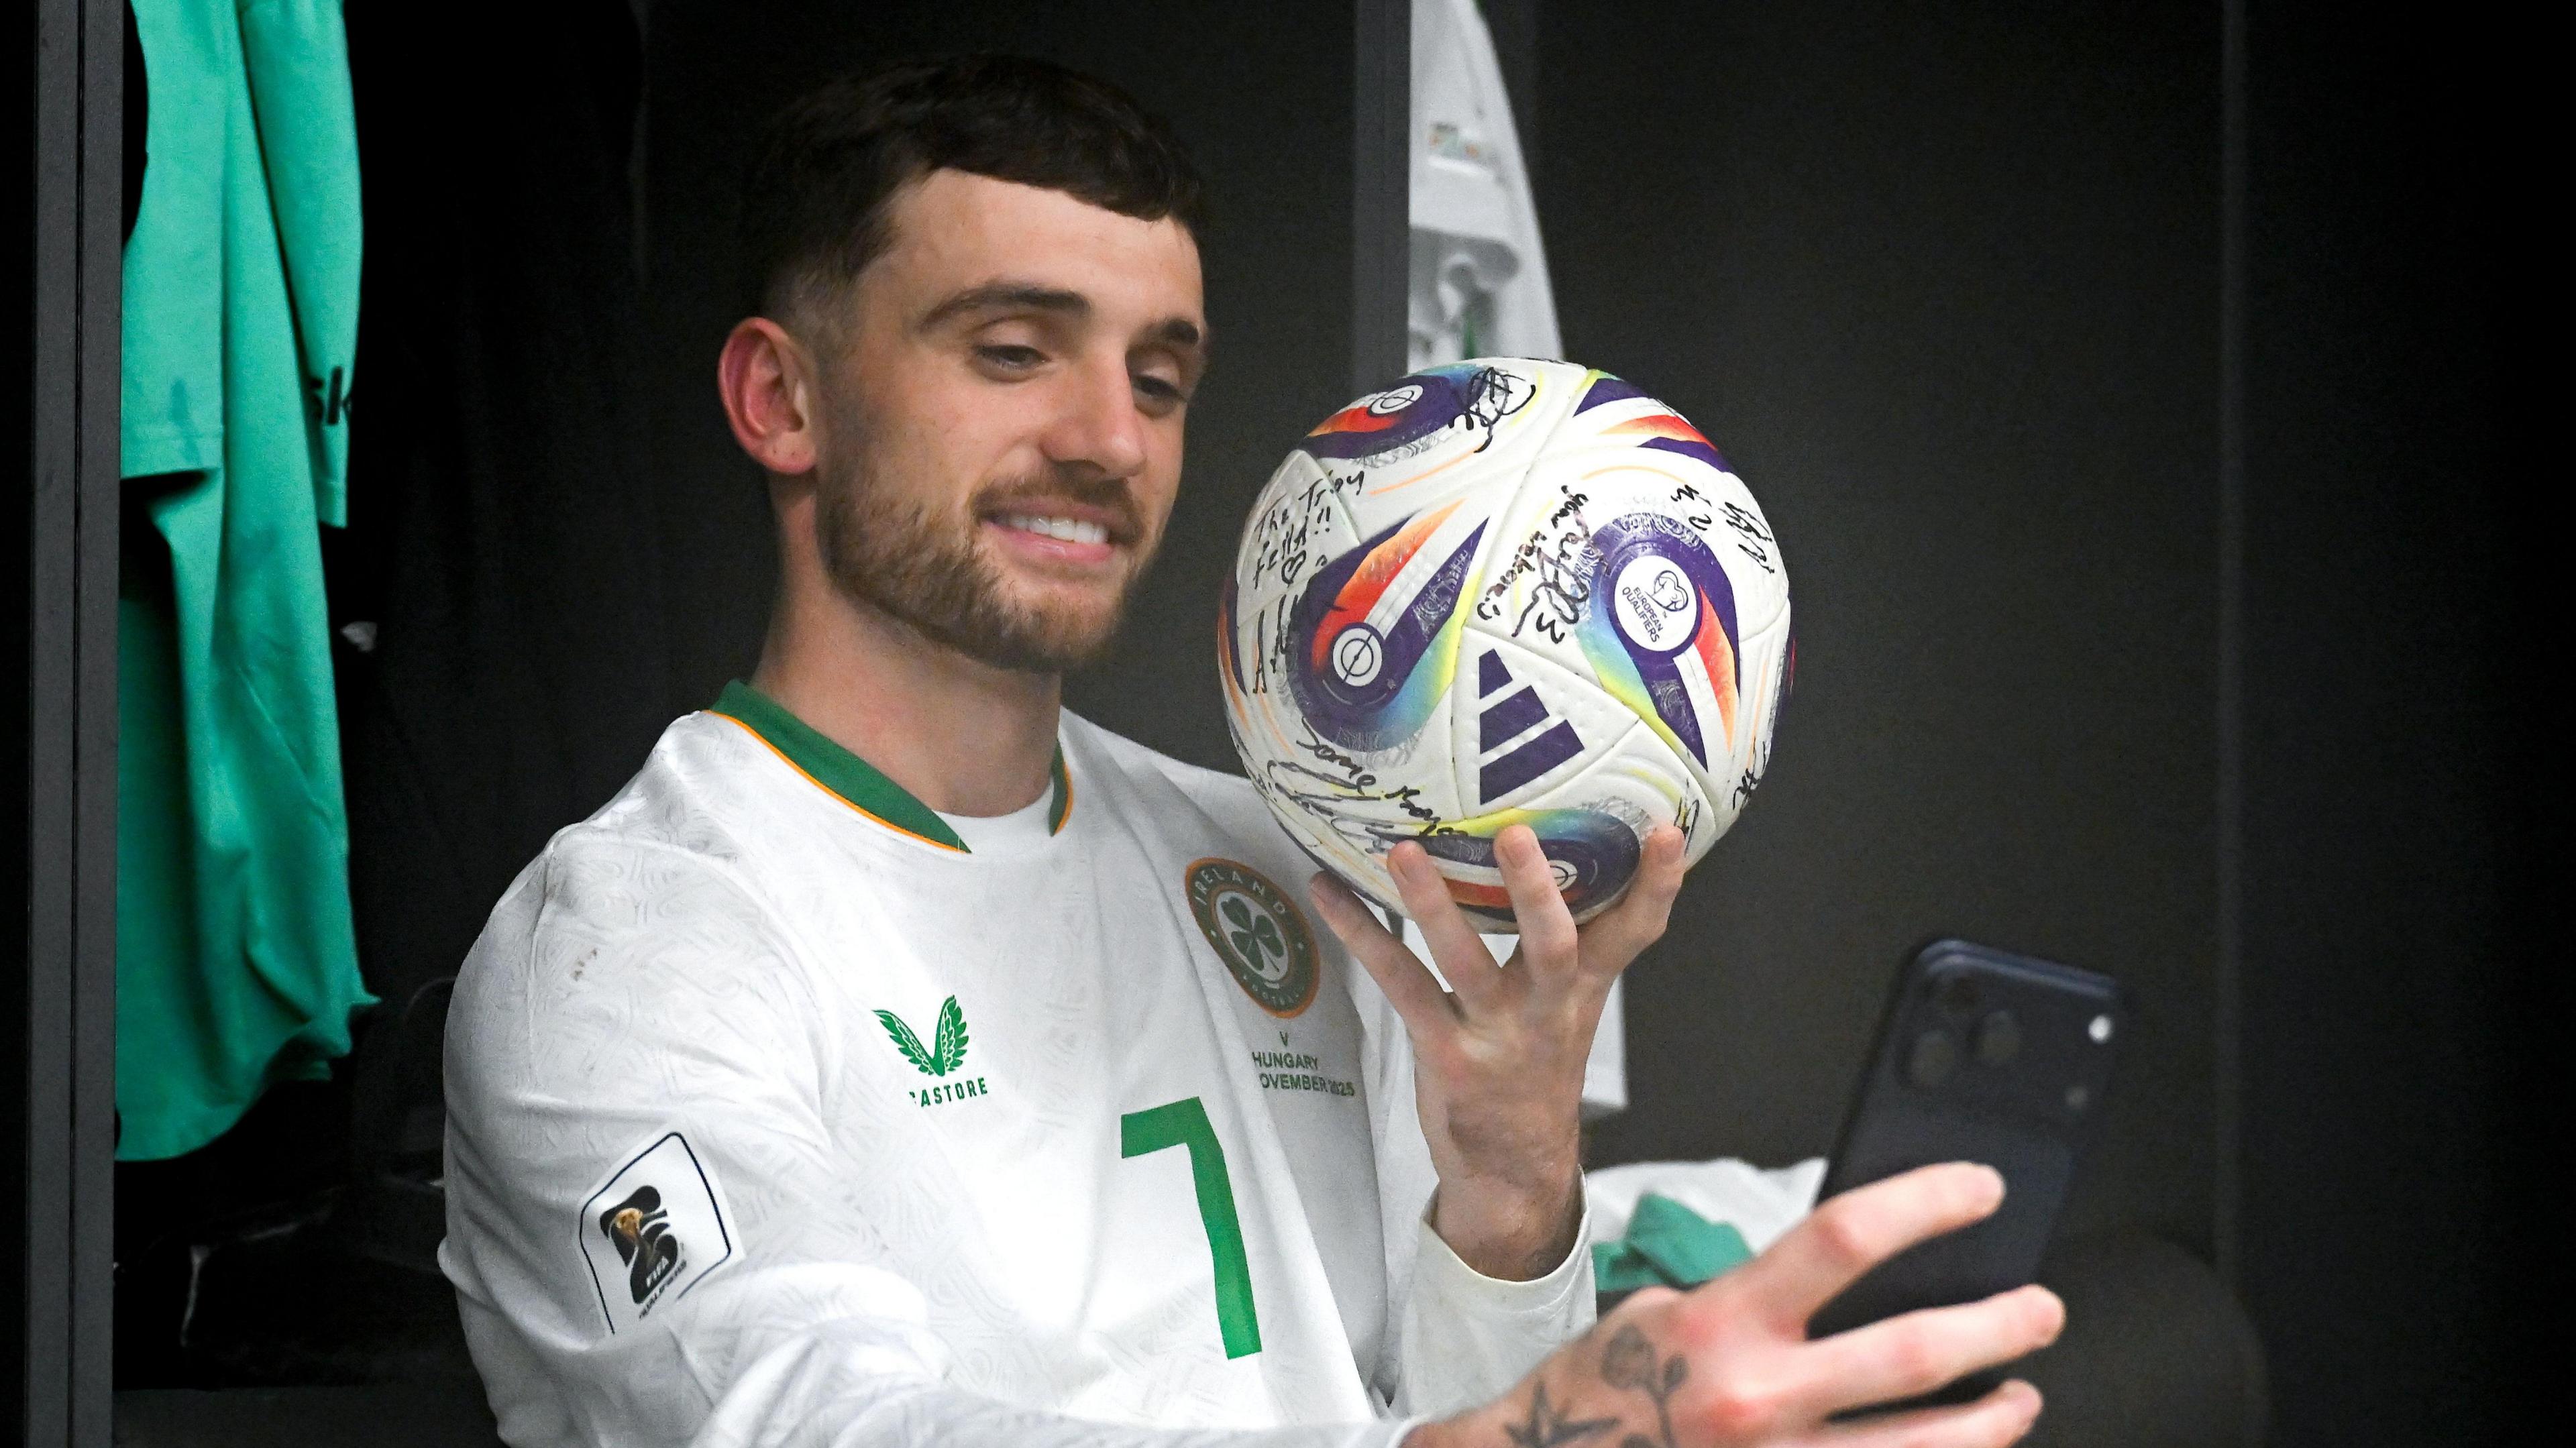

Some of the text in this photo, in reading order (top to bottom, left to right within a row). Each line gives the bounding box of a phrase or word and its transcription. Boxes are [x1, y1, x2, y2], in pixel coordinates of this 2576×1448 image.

[1622, 586, 1660, 643] QUALIFIERS
[1633, 586, 1664, 632] EUROPEAN
[1194, 867, 1286, 915] IRELAND
[1251, 1050, 1319, 1070] HUNGARY
[1258, 1072, 1328, 1093] OVEMBER
[1121, 1096, 1263, 1360] 7
